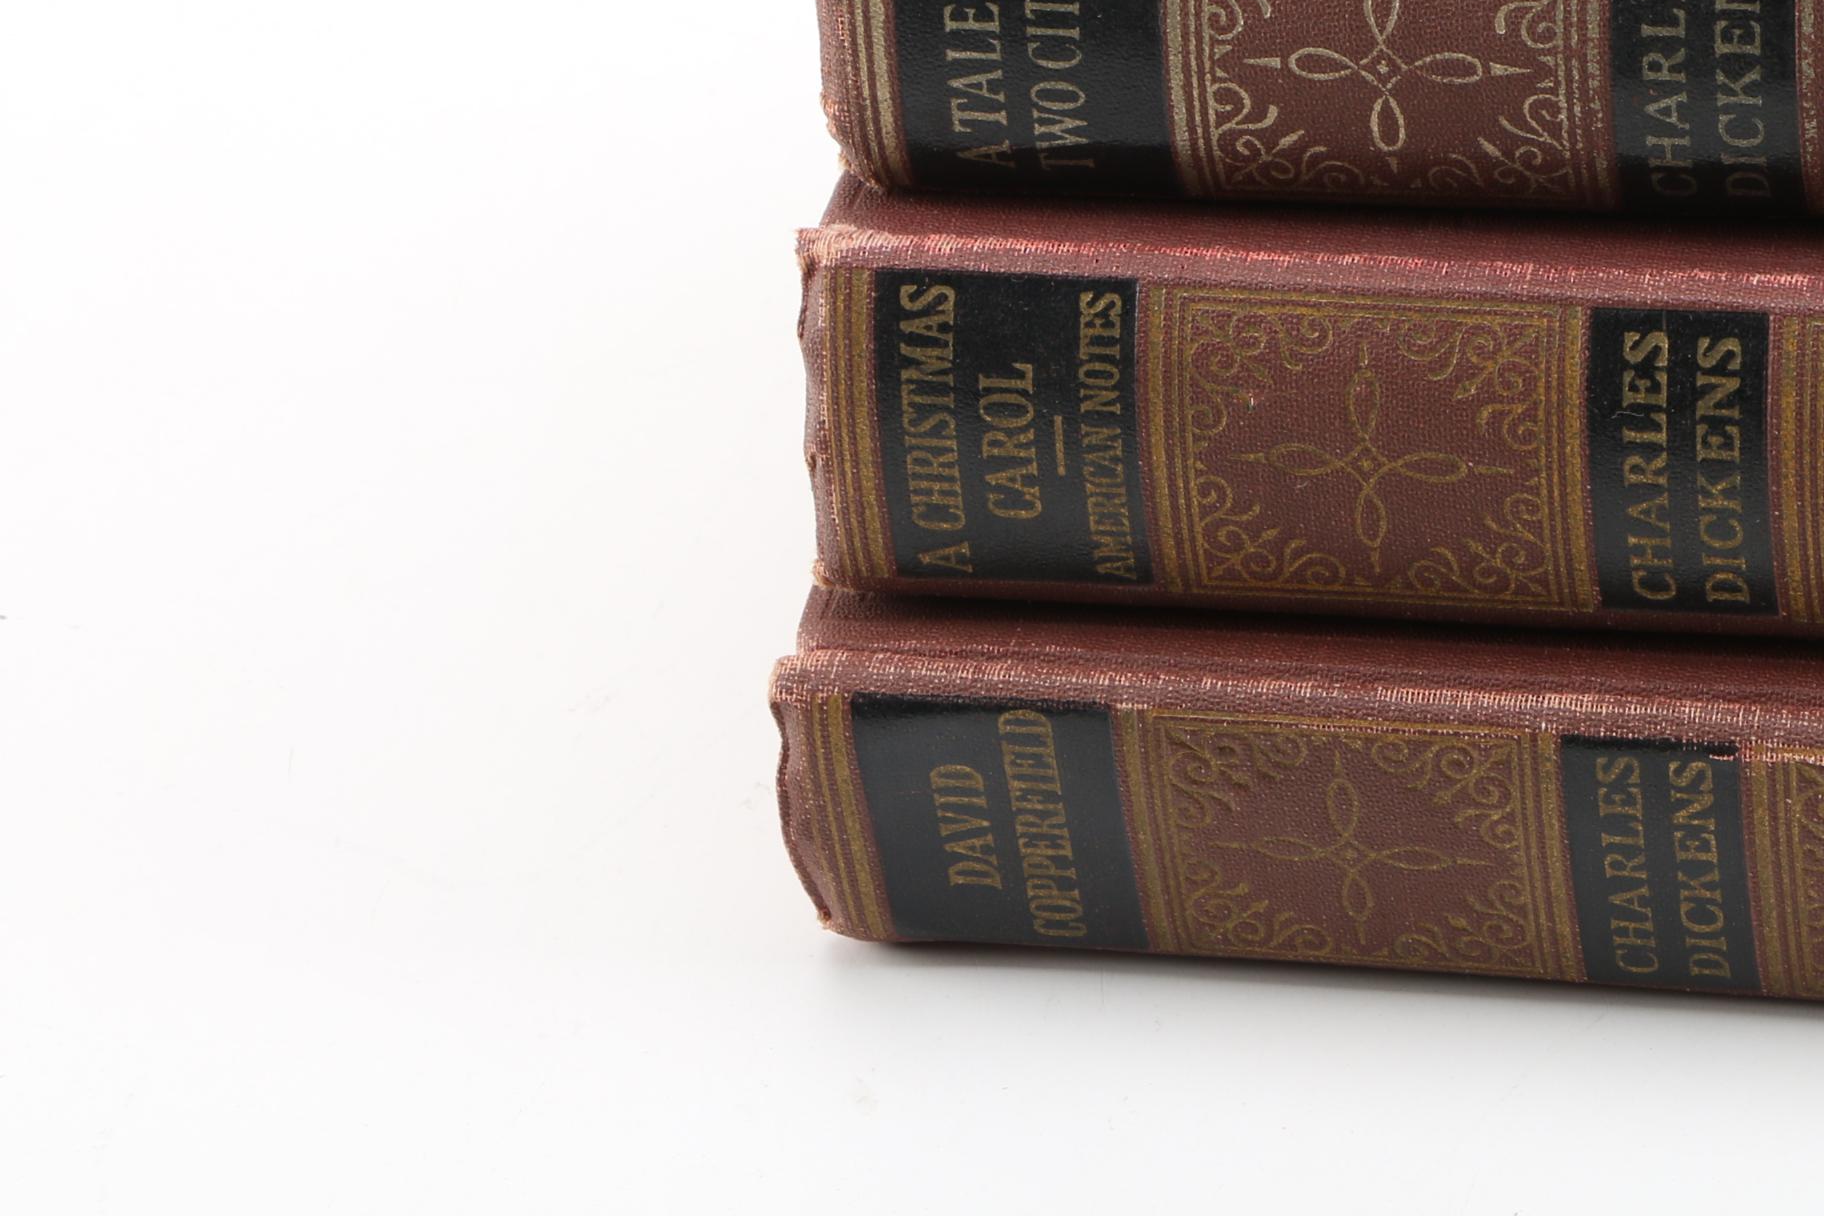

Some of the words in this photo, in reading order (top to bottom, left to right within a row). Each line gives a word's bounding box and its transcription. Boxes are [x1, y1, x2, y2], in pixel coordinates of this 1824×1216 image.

[943, 1, 1008, 133] TALE
[1030, 80, 1096, 171] TWO
[957, 139, 1016, 169] A
[899, 283, 966, 531] CHRISTMAS
[1078, 290, 1122, 415] NOTES
[978, 361, 1043, 520] CAROL
[1080, 423, 1137, 580] AMERICAN
[1621, 330, 1677, 601] CHARLES
[1695, 336, 1750, 604] DICKENS
[916, 540, 974, 573] A
[929, 764, 1002, 890] DAVID
[998, 709, 1088, 937] COPPERFIELD
[1595, 755, 1660, 974] CHARLES
[1668, 760, 1732, 979] DICKENS
